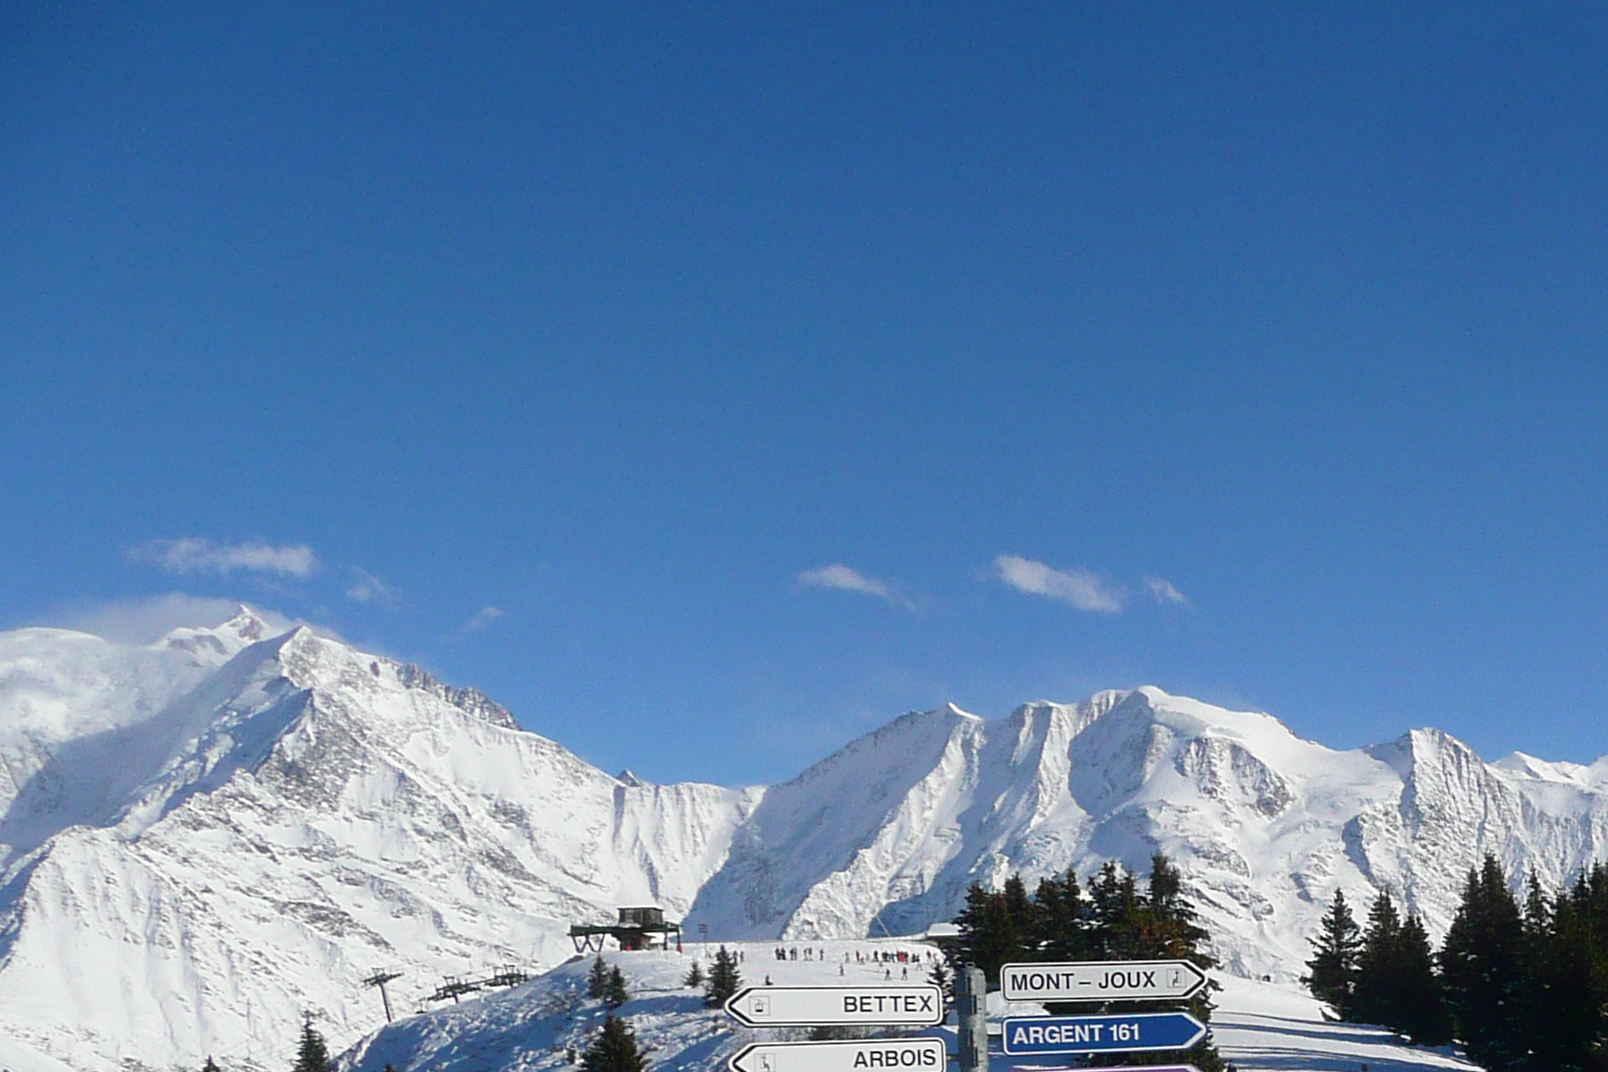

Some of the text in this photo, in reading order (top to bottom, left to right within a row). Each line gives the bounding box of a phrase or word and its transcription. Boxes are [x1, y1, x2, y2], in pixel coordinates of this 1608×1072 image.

[843, 995, 933, 1013] BETTEX
[1012, 1023, 1140, 1045] ARGENT 161
[853, 1048, 937, 1068] ARBOIS
